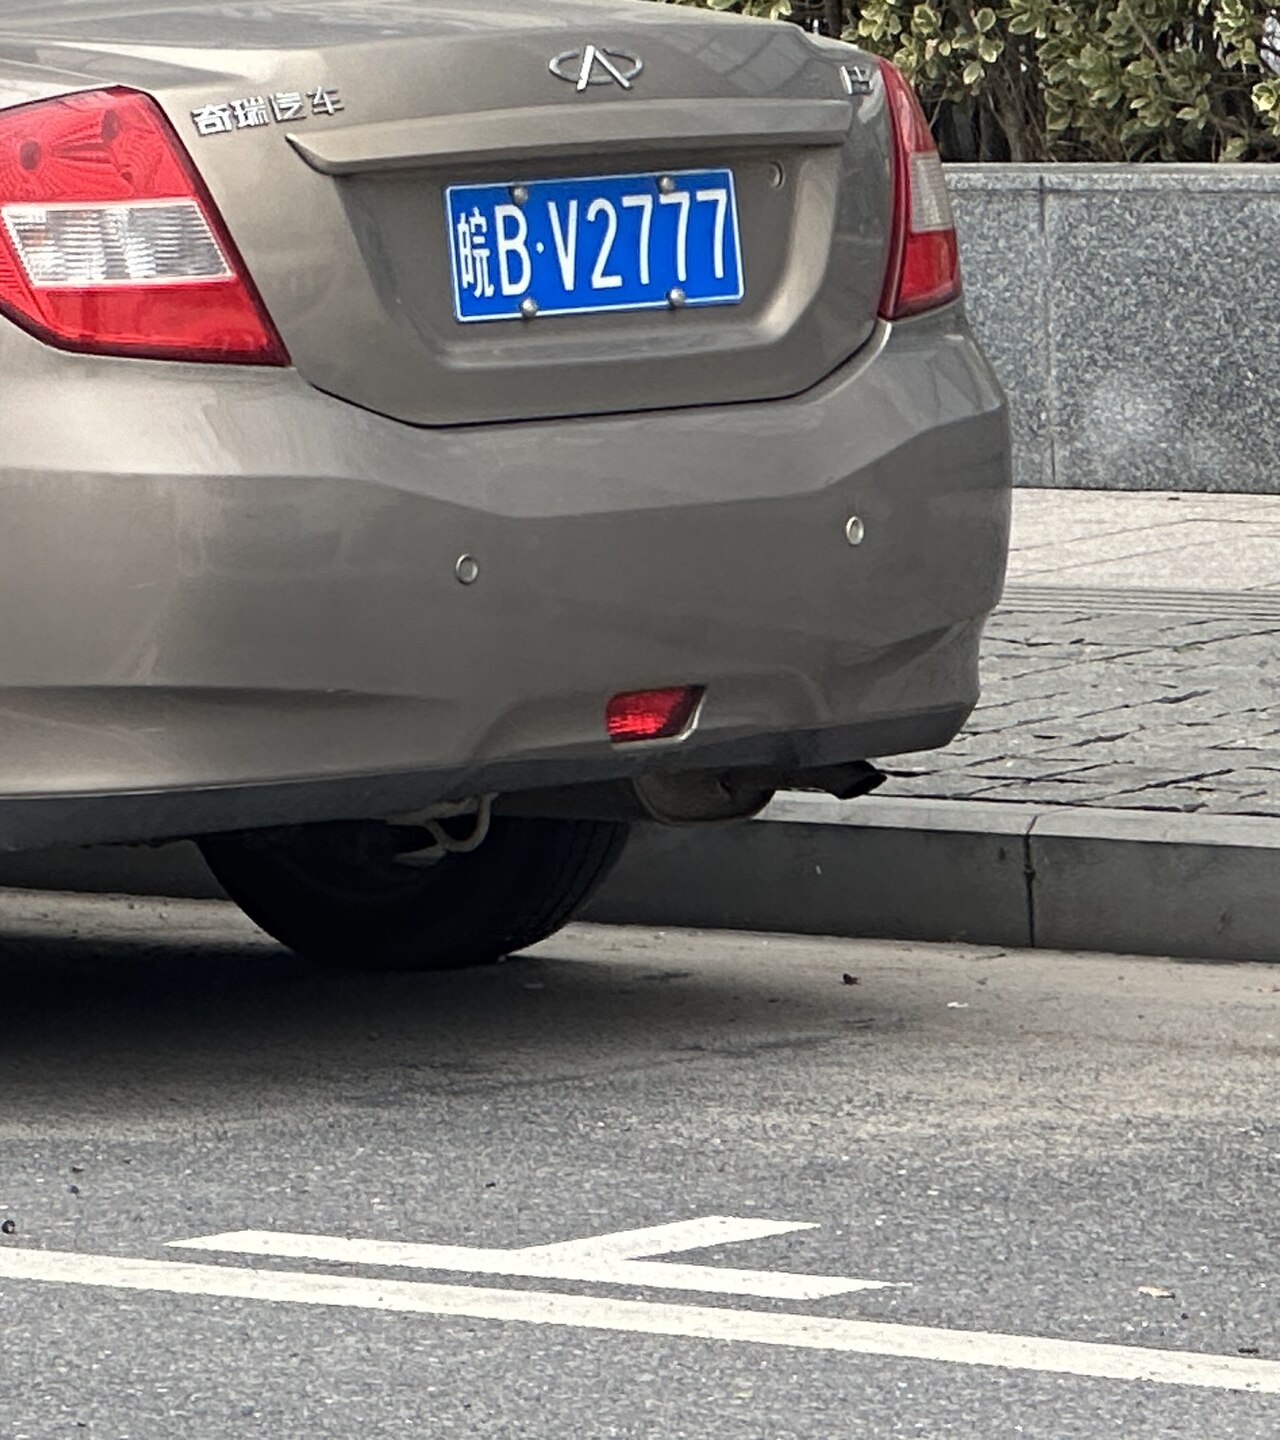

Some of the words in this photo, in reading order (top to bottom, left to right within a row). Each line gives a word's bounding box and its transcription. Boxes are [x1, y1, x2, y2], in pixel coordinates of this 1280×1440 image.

[191, 86, 345, 137] 奇瑞汽车
[456, 187, 730, 300] 皖B·V2777
